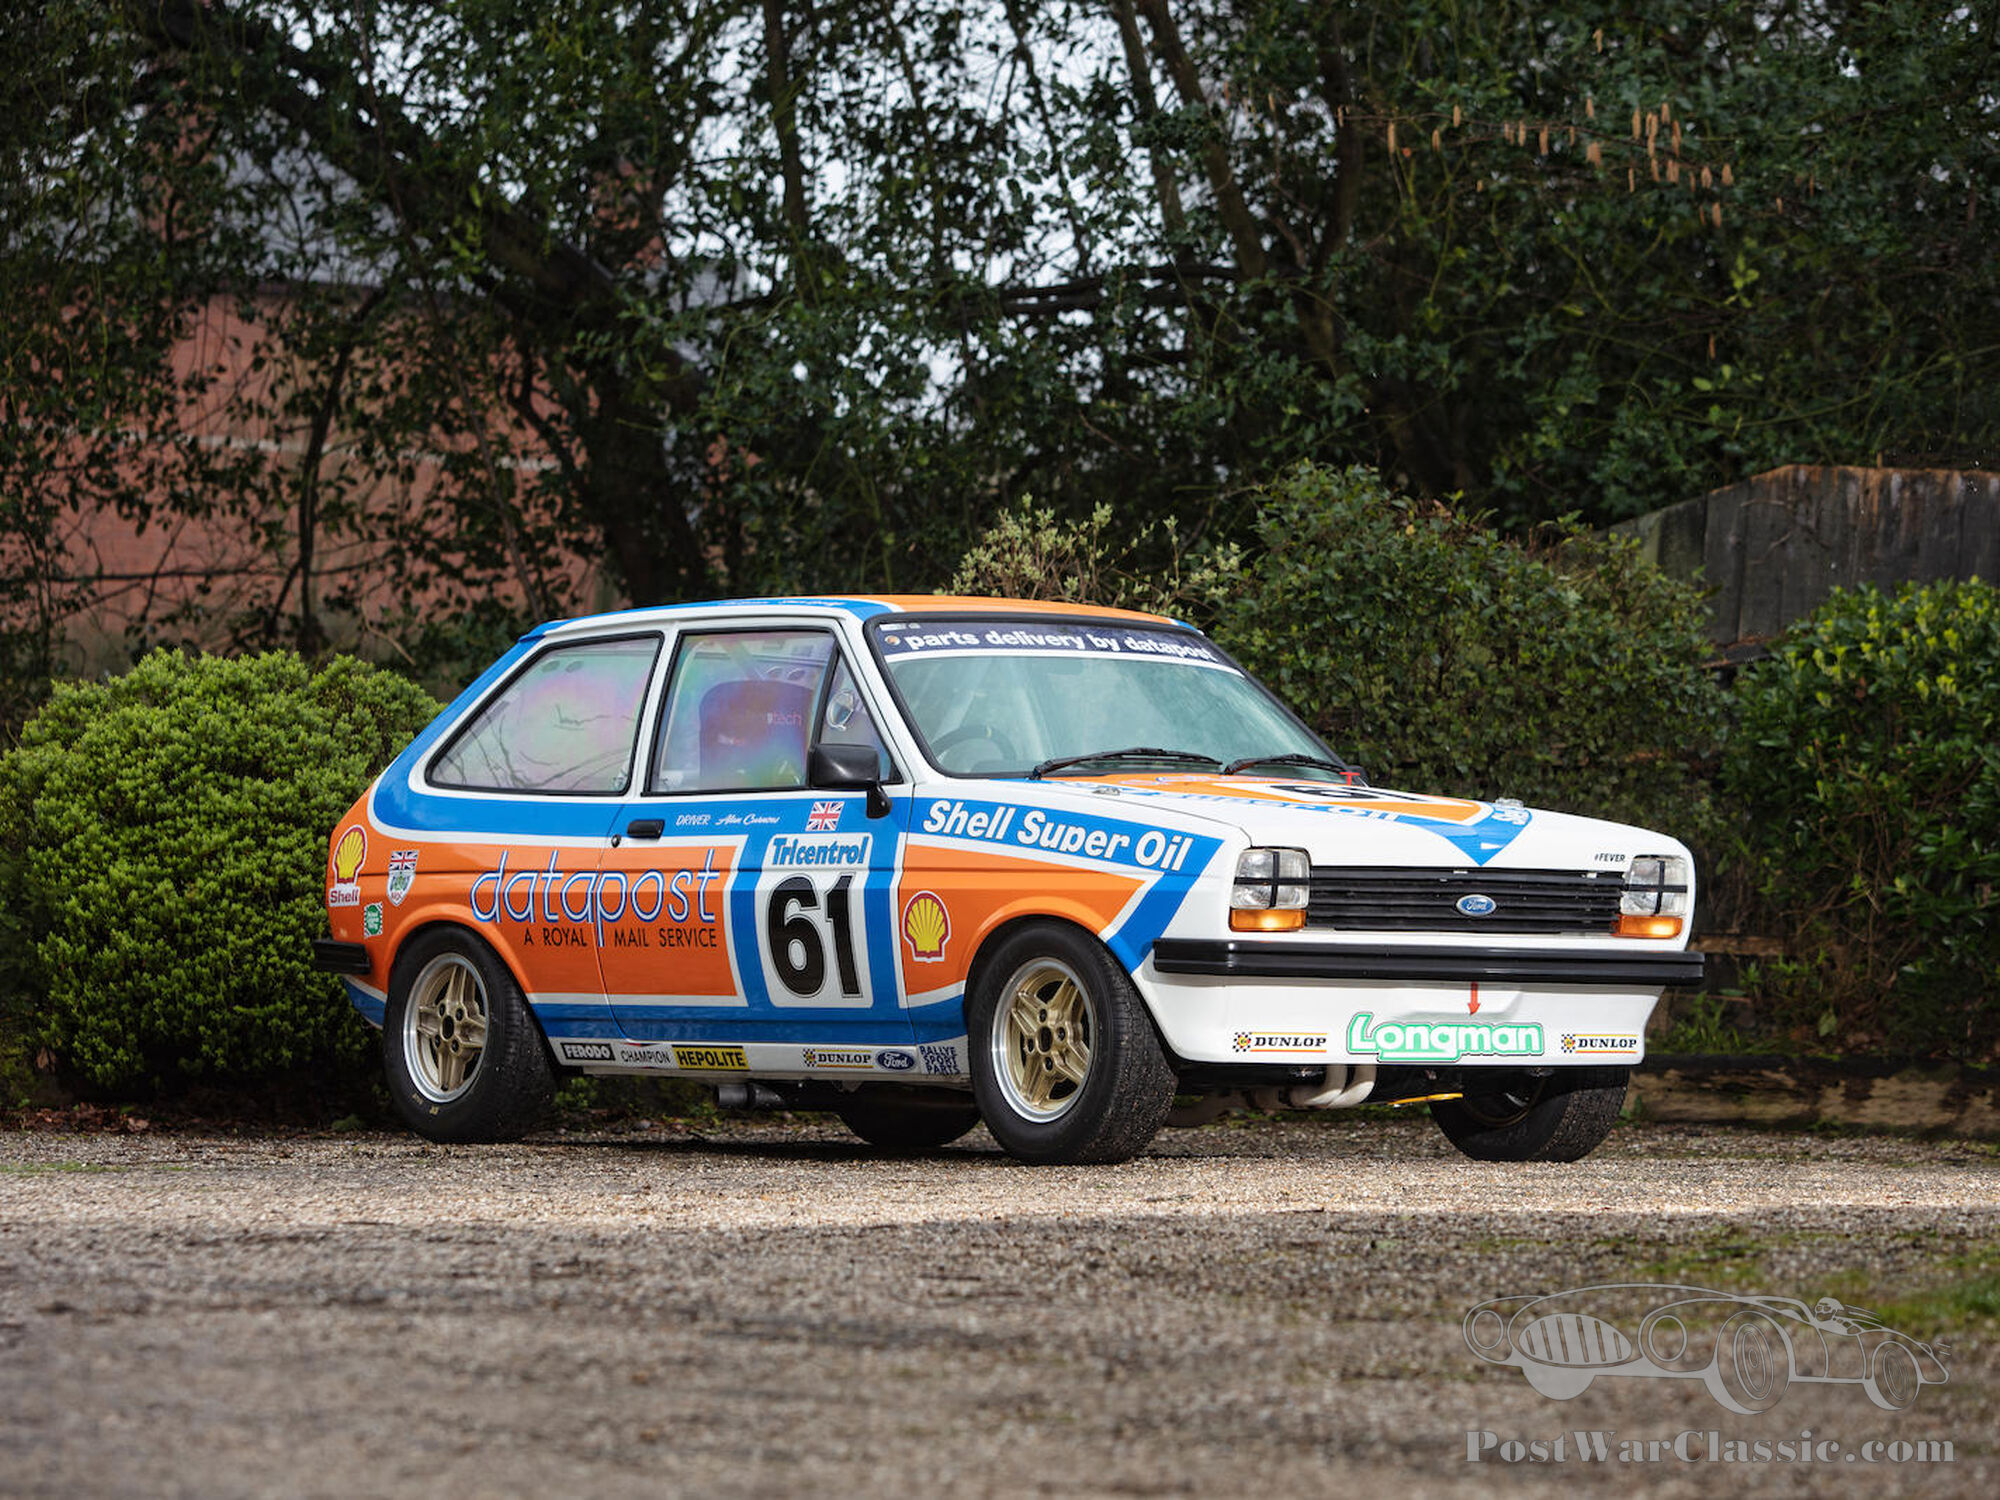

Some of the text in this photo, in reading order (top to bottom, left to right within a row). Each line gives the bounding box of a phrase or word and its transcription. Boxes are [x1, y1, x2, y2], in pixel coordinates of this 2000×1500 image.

[904, 630, 1219, 662] parts delivery by datapost
[676, 814, 711, 826] DRIVER
[923, 800, 1193, 871] Shell Super Oil
[772, 835, 869, 866] Tricentrol
[329, 890, 359, 904] Shell
[470, 848, 720, 948] datapost
[524, 928, 717, 947] A ROYAL MAIL SERVICE
[768, 872, 863, 998] 61
[1254, 1036, 1327, 1048] DUNLOP
[1348, 1013, 1544, 1061] Longman
[1577, 1037, 1638, 1049] DUNLOP
[564, 1044, 612, 1059] FERODO
[620, 1049, 671, 1064] CHAMPION
[919, 1045, 957, 1056] RALLYE
[677, 1050, 746, 1067] HEPOLITE
[818, 1053, 872, 1064] DUNLOP
[923, 1054, 957, 1066] SPORT
[926, 1064, 961, 1076] PARTS
